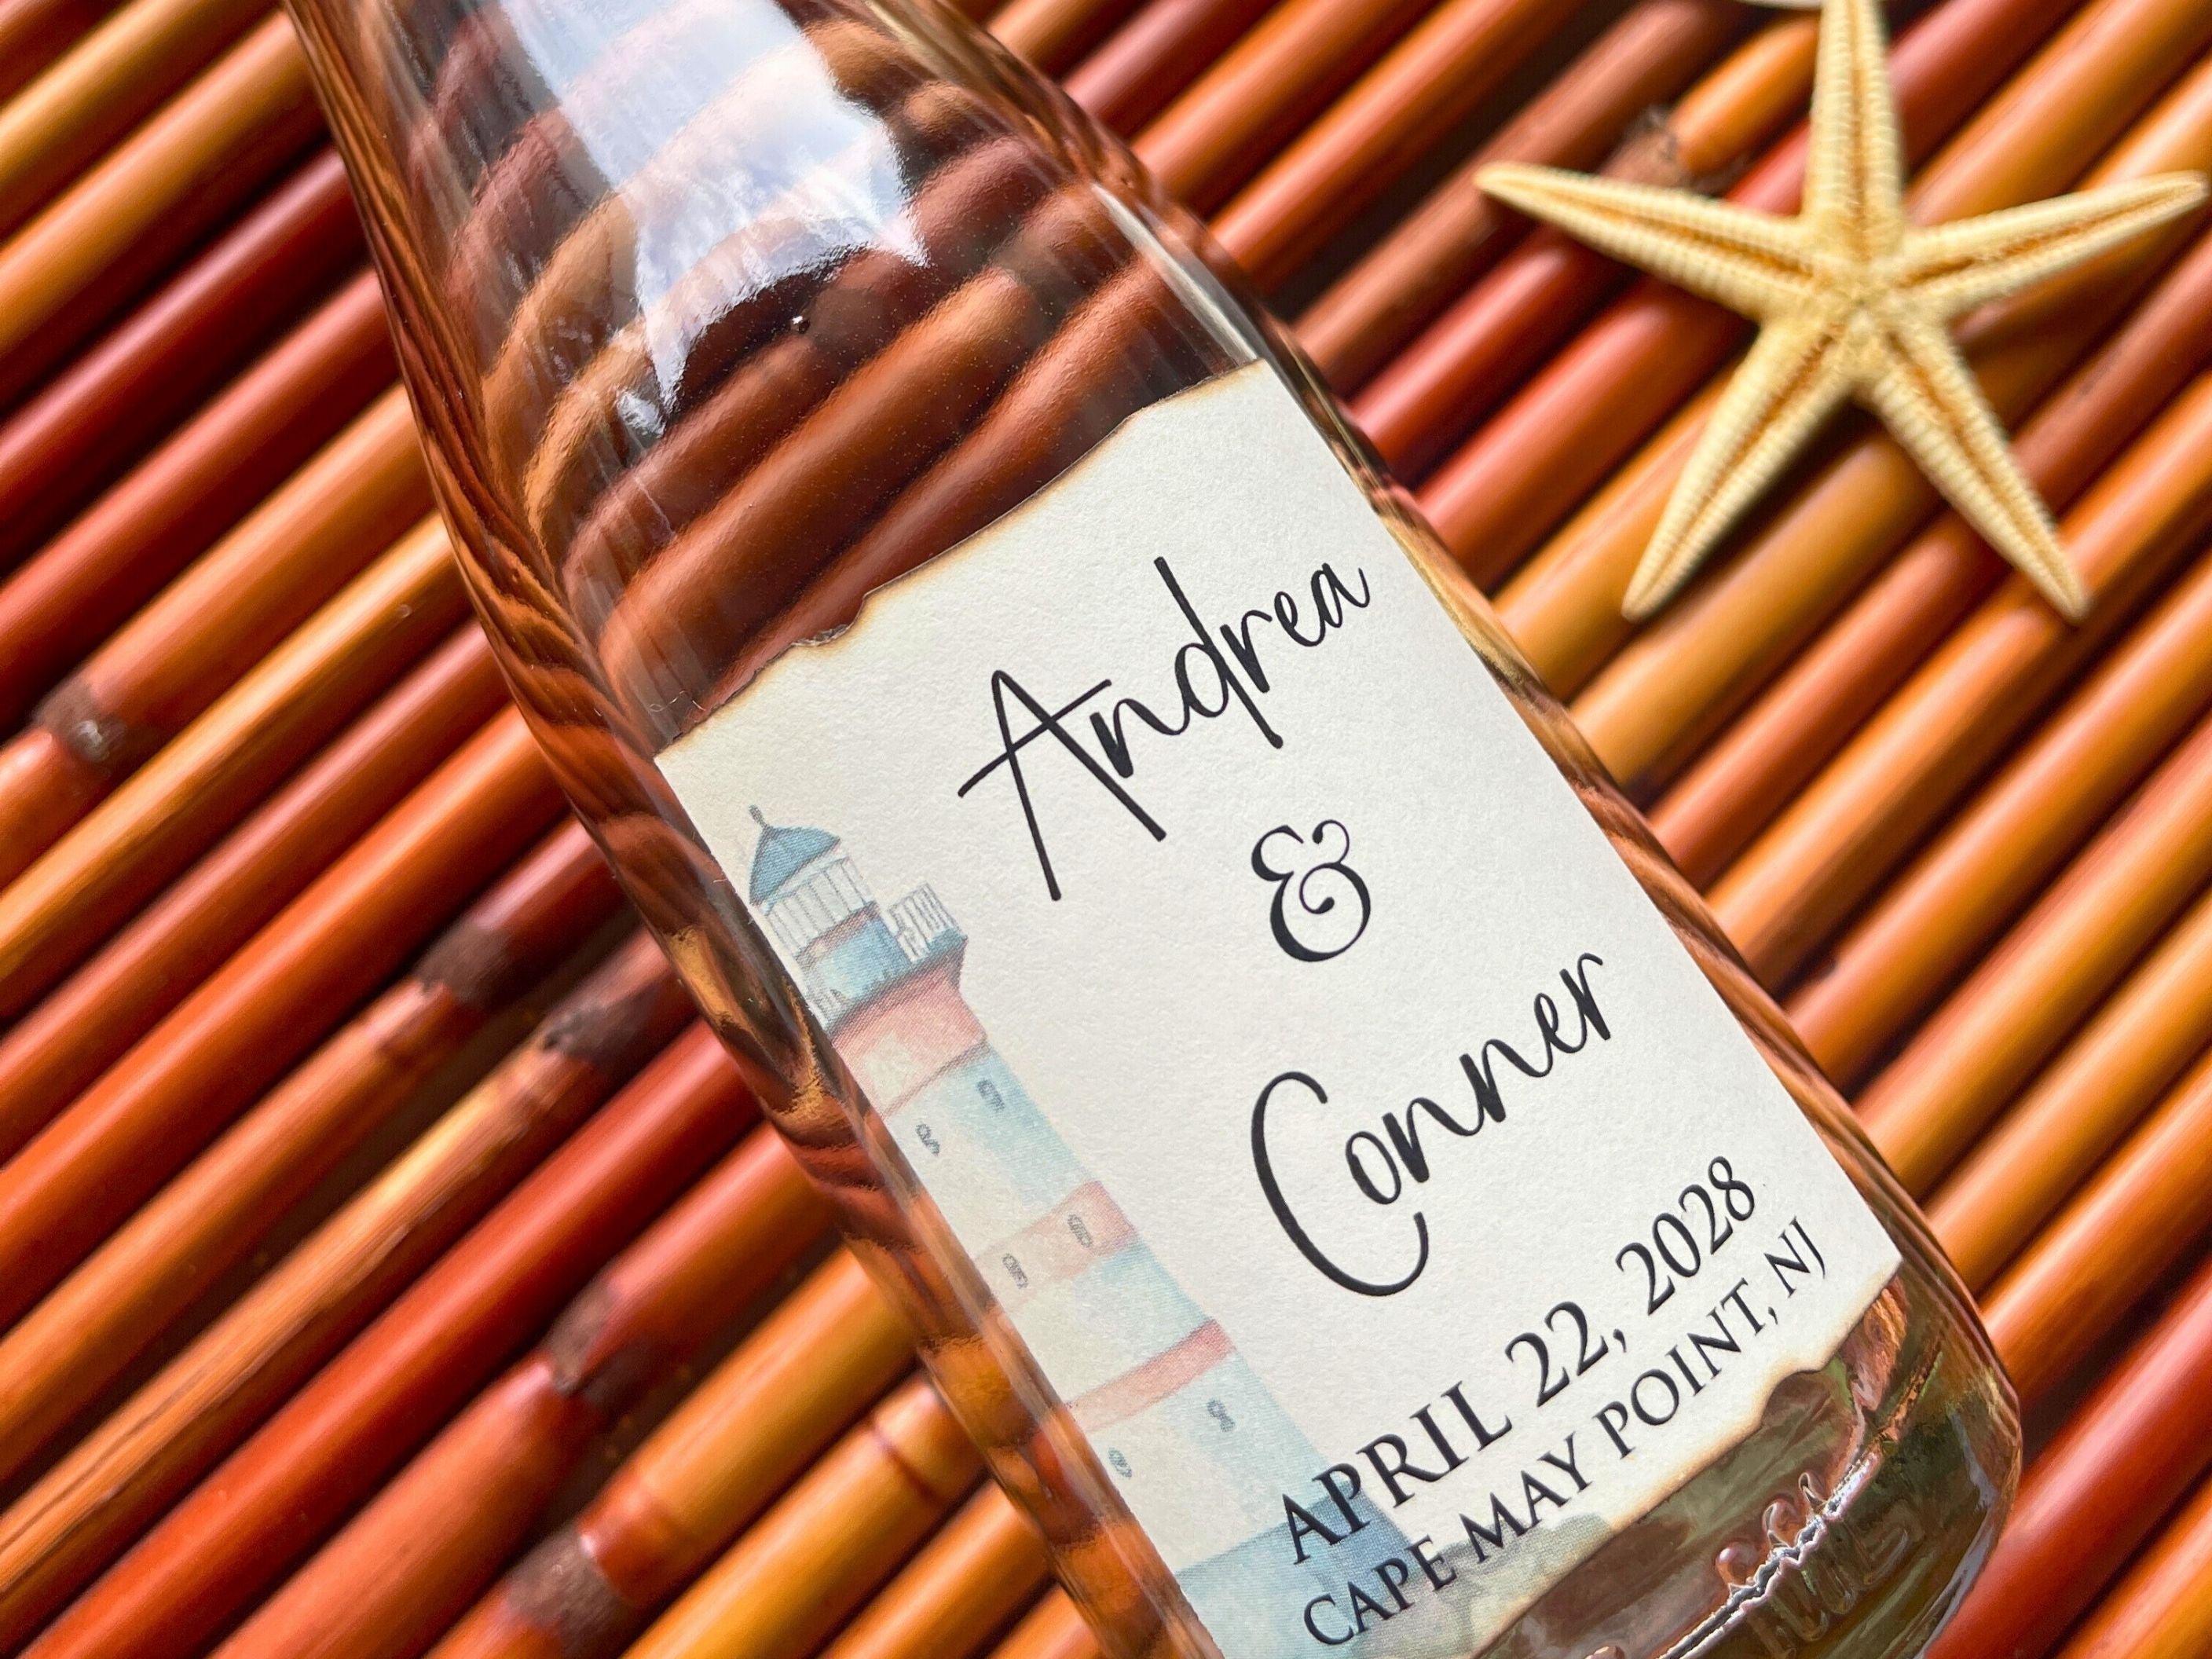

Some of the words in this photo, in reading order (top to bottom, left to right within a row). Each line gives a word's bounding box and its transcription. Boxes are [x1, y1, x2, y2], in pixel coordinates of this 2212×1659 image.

[957, 555, 1372, 903] Andrea
[1251, 819, 1372, 964] &
[1251, 951, 1612, 1298] Conner
[1281, 1380, 1514, 1566] APRIL
[1503, 1300, 1628, 1408] 22,
[1614, 1155, 1756, 1317] 2028
[1302, 1535, 1459, 1647] CAPE
[1459, 1431, 1593, 1566] MAY
[1593, 1276, 1780, 1460] POINT,
[1763, 1215, 1828, 1298] NJ
